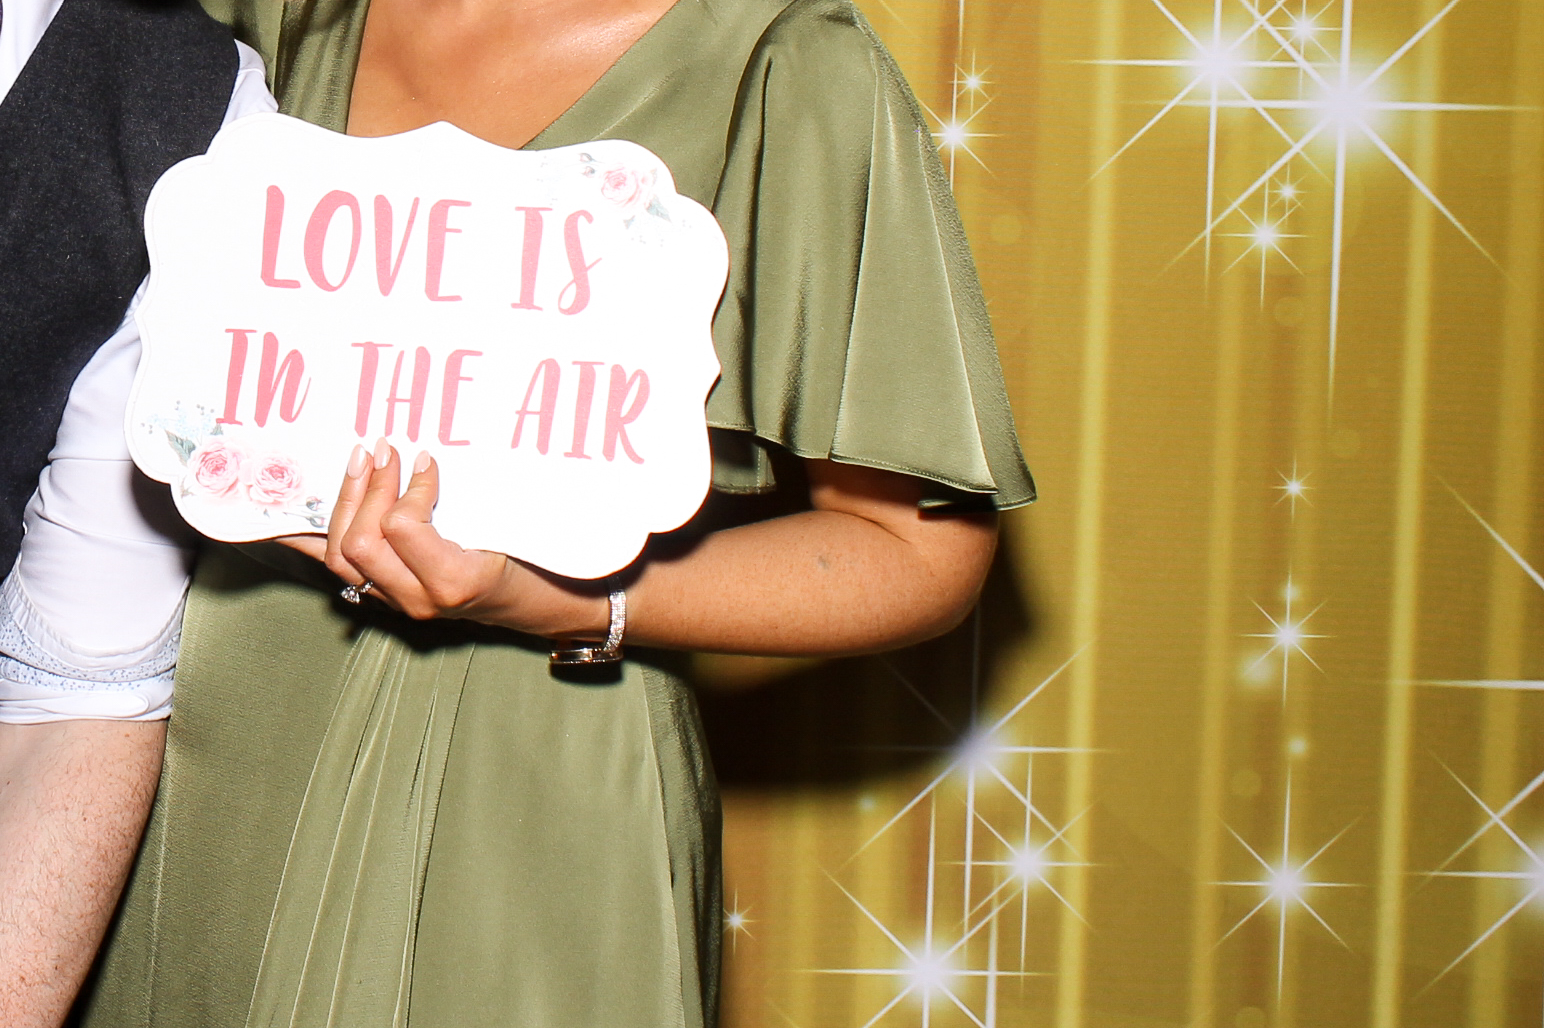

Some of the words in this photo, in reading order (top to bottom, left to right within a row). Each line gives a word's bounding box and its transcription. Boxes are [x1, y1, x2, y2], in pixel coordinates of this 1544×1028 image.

[261, 185, 471, 302] LOVE
[511, 206, 602, 315] IS
[351, 341, 483, 446] THE
[511, 358, 651, 464] AIR
